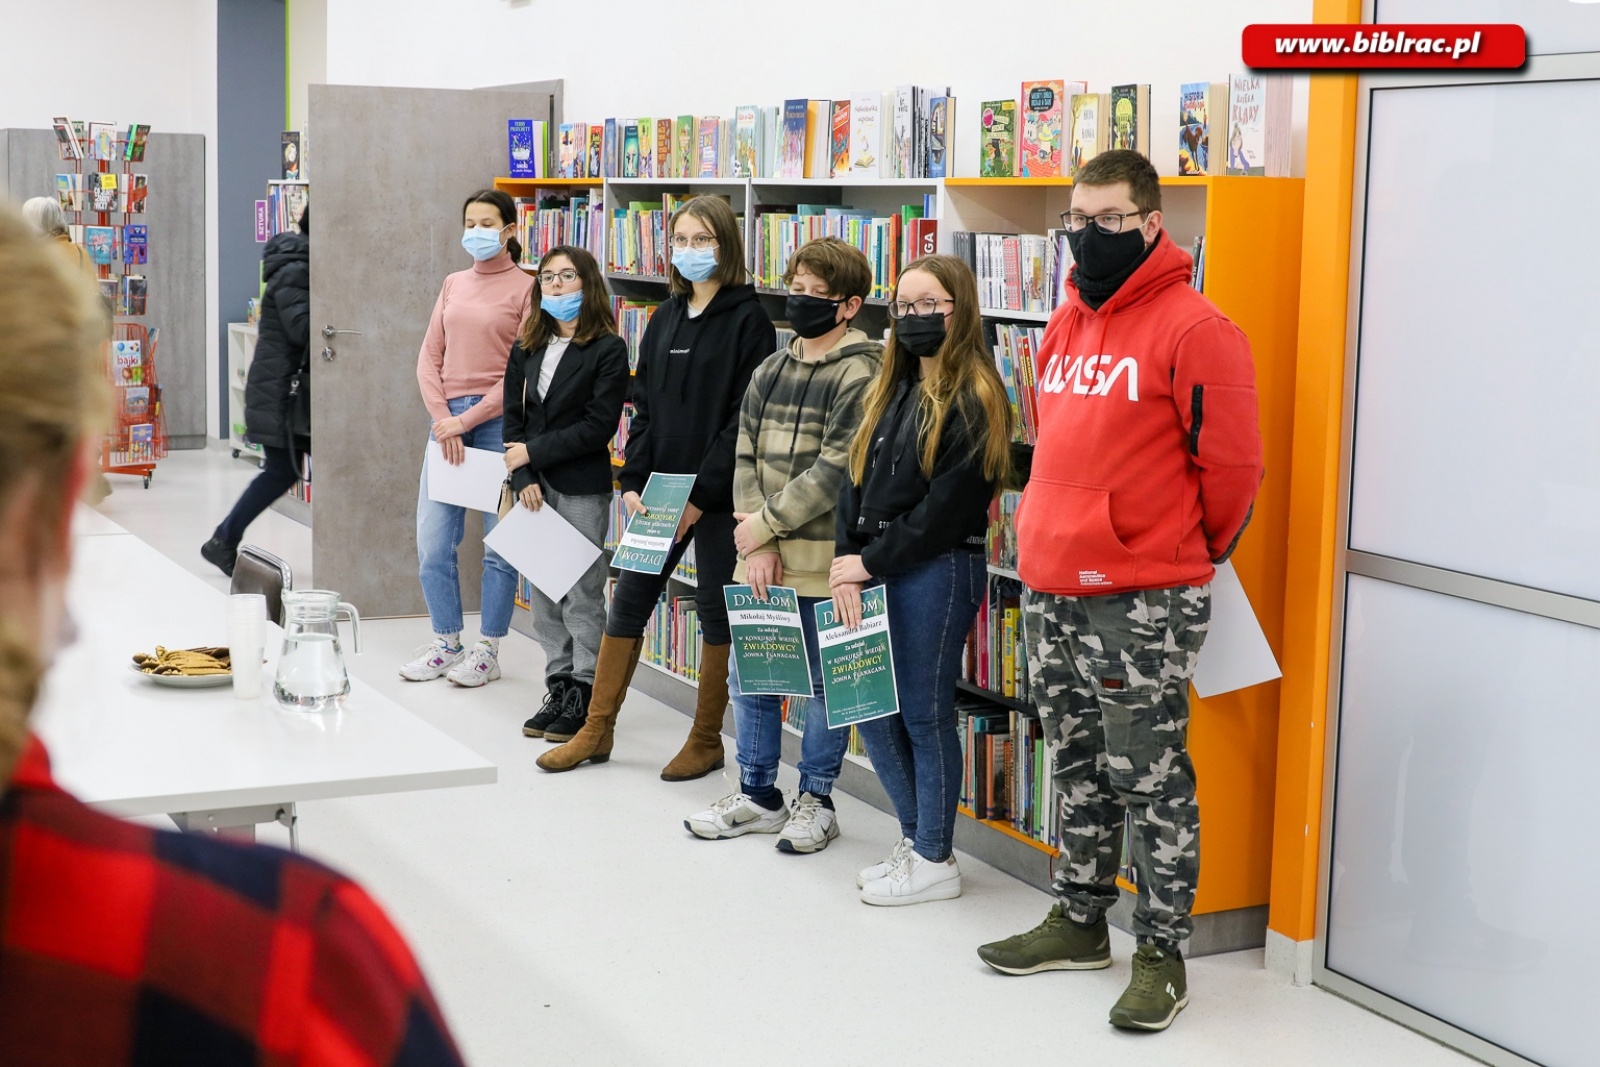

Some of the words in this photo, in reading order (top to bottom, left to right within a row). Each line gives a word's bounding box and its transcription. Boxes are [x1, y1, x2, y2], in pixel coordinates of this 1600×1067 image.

[1234, 77, 1260, 92] WIELKA
[1232, 104, 1259, 125] KLARY
[117, 355, 138, 366] bajki
[1040, 353, 1139, 402] NASA
[622, 550, 662, 566] DYPLOM
[766, 613, 791, 622] Myśliwy
[825, 626, 858, 641] Aleksandra
[859, 620, 882, 631] Babiarz
[743, 643, 796, 651] ZWIADOWCY
[832, 654, 882, 675] ZWIADOWCY
